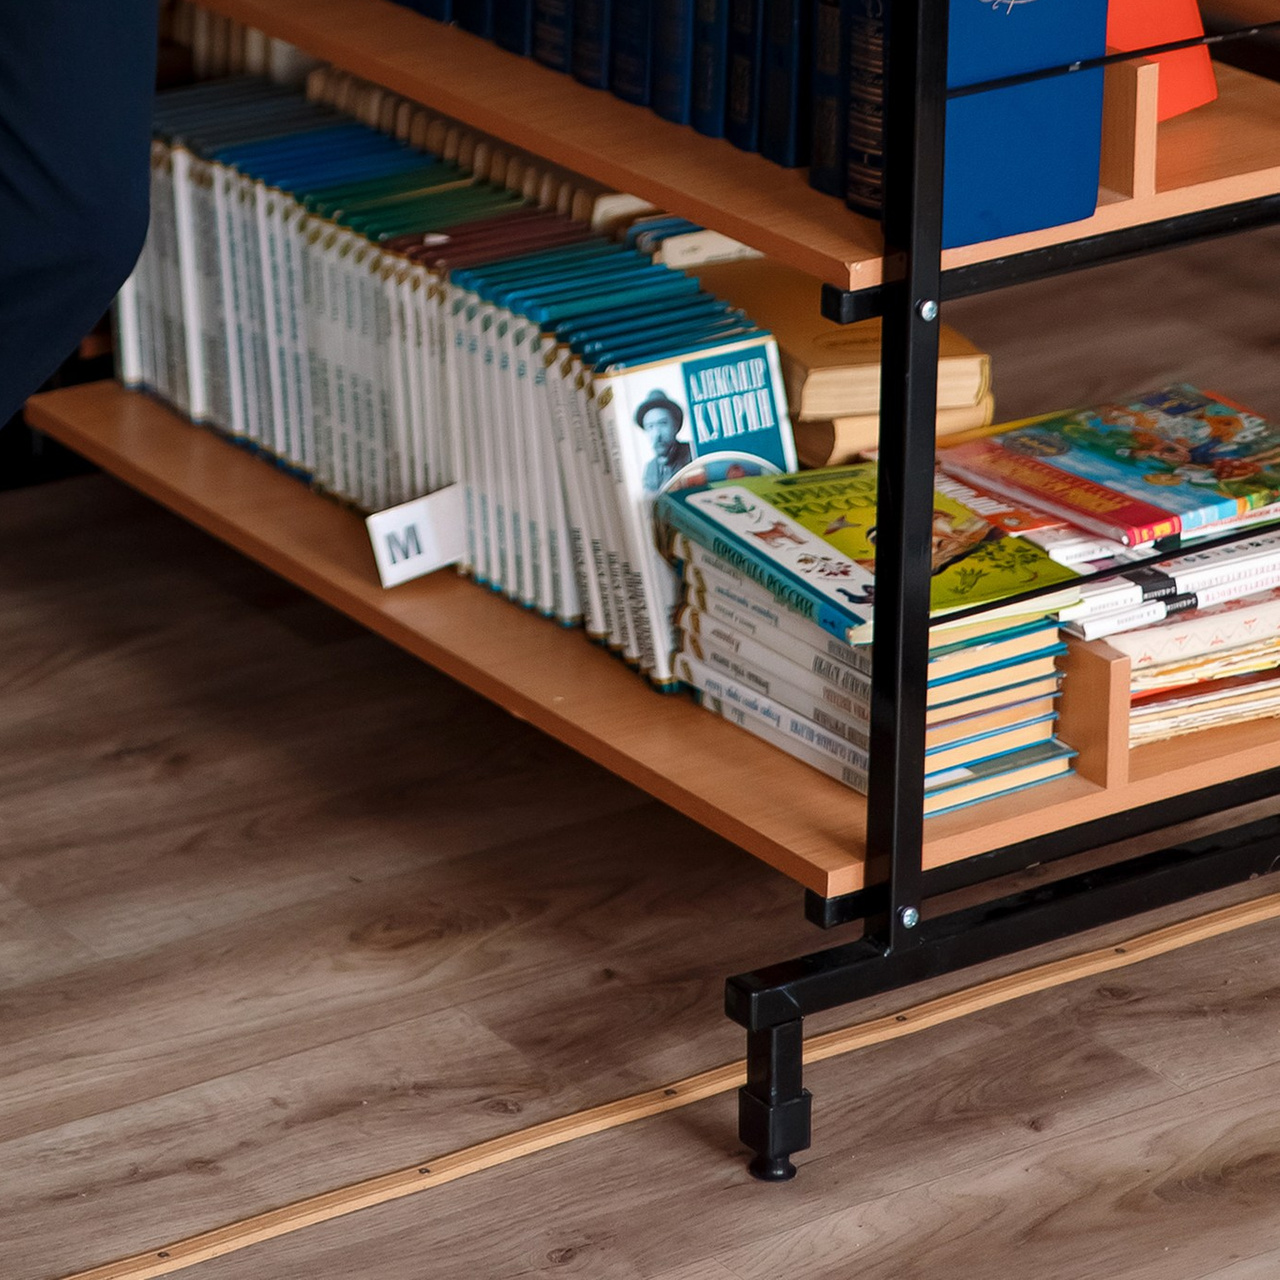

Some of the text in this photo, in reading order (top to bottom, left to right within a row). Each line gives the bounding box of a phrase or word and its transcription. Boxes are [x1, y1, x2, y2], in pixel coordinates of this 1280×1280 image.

[689, 356, 767, 403] АЛЕКСАНДР
[693, 388, 776, 444] КУПРИН
[763, 480, 877, 506] ПРИРО
[782, 496, 877, 519] РОСС
[384, 522, 424, 565] М
